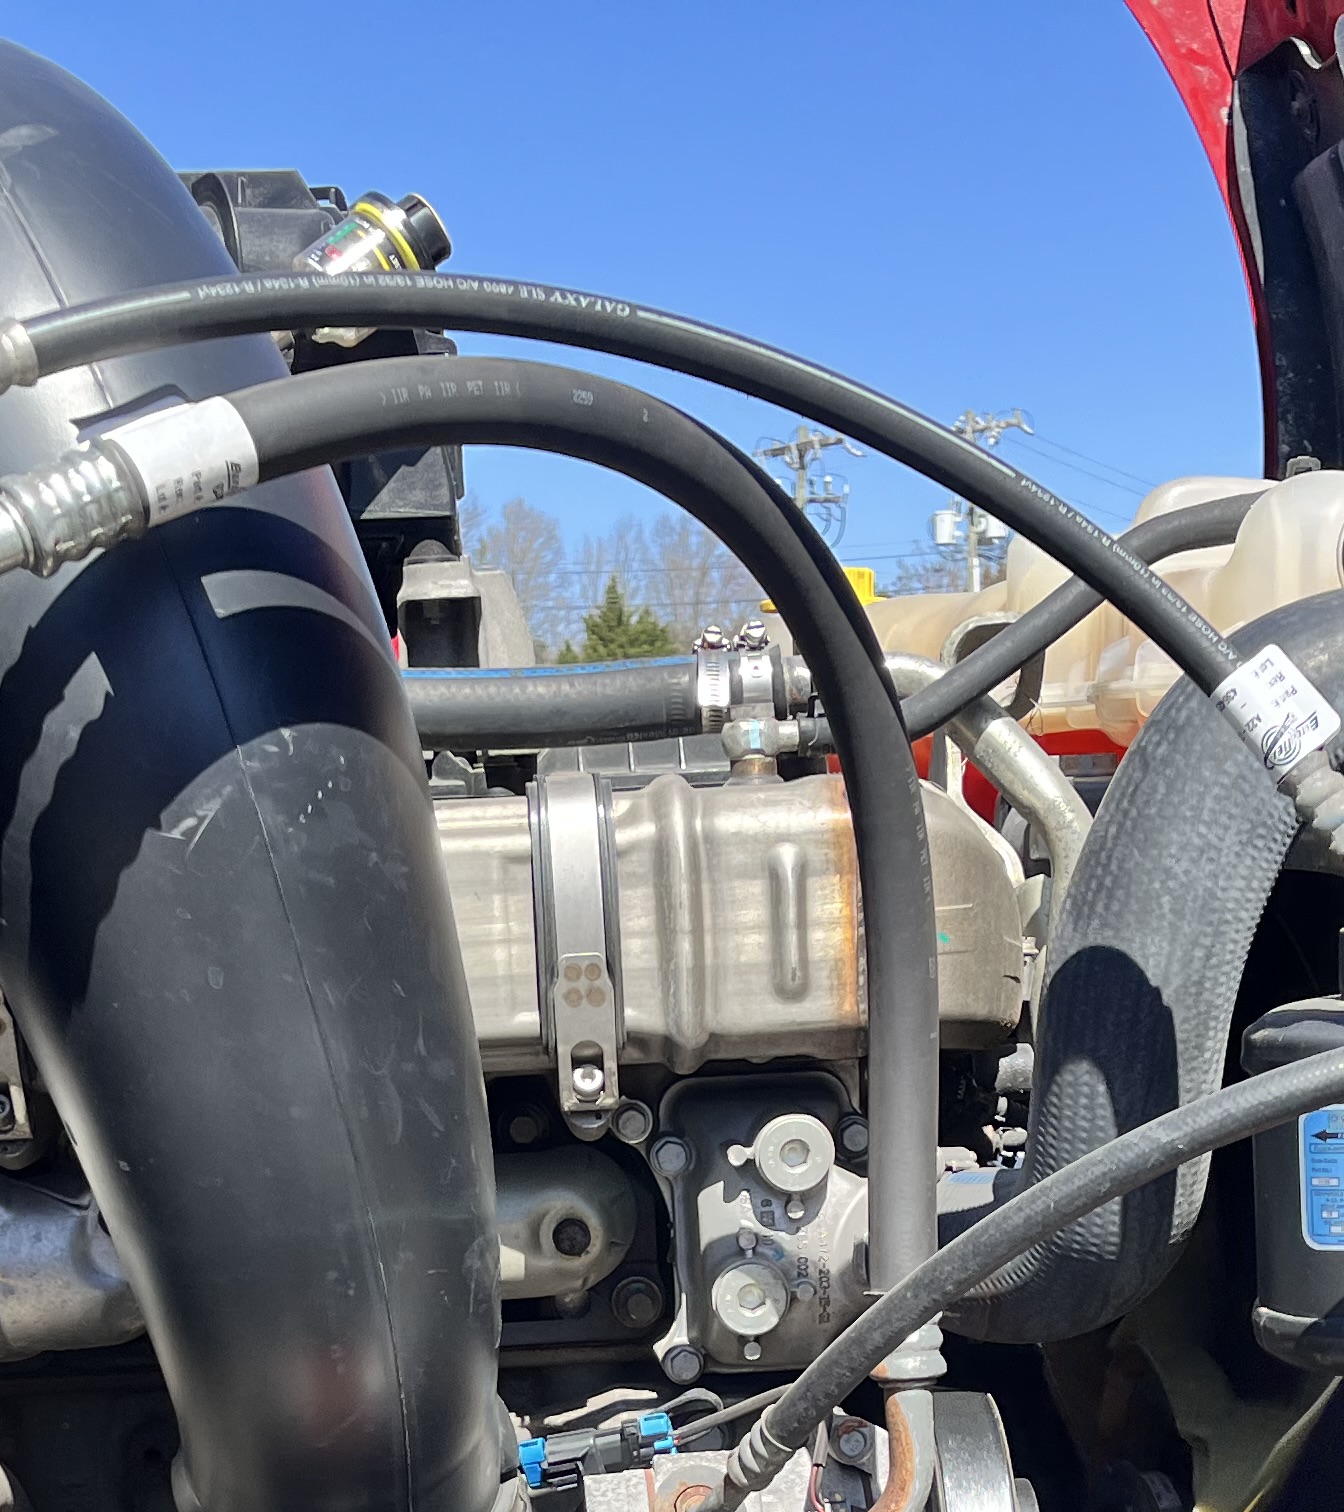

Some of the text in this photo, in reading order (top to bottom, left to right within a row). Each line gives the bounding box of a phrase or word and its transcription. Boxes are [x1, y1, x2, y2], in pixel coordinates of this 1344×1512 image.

[415, 275, 453, 290] HOSE
[457, 278, 479, 291] A/C
[519, 285, 546, 301] SLE
[551, 291, 630, 317] GALAXY
[1188, 613, 1219, 643] HOSE
[1217, 641, 1236, 661] A/C
